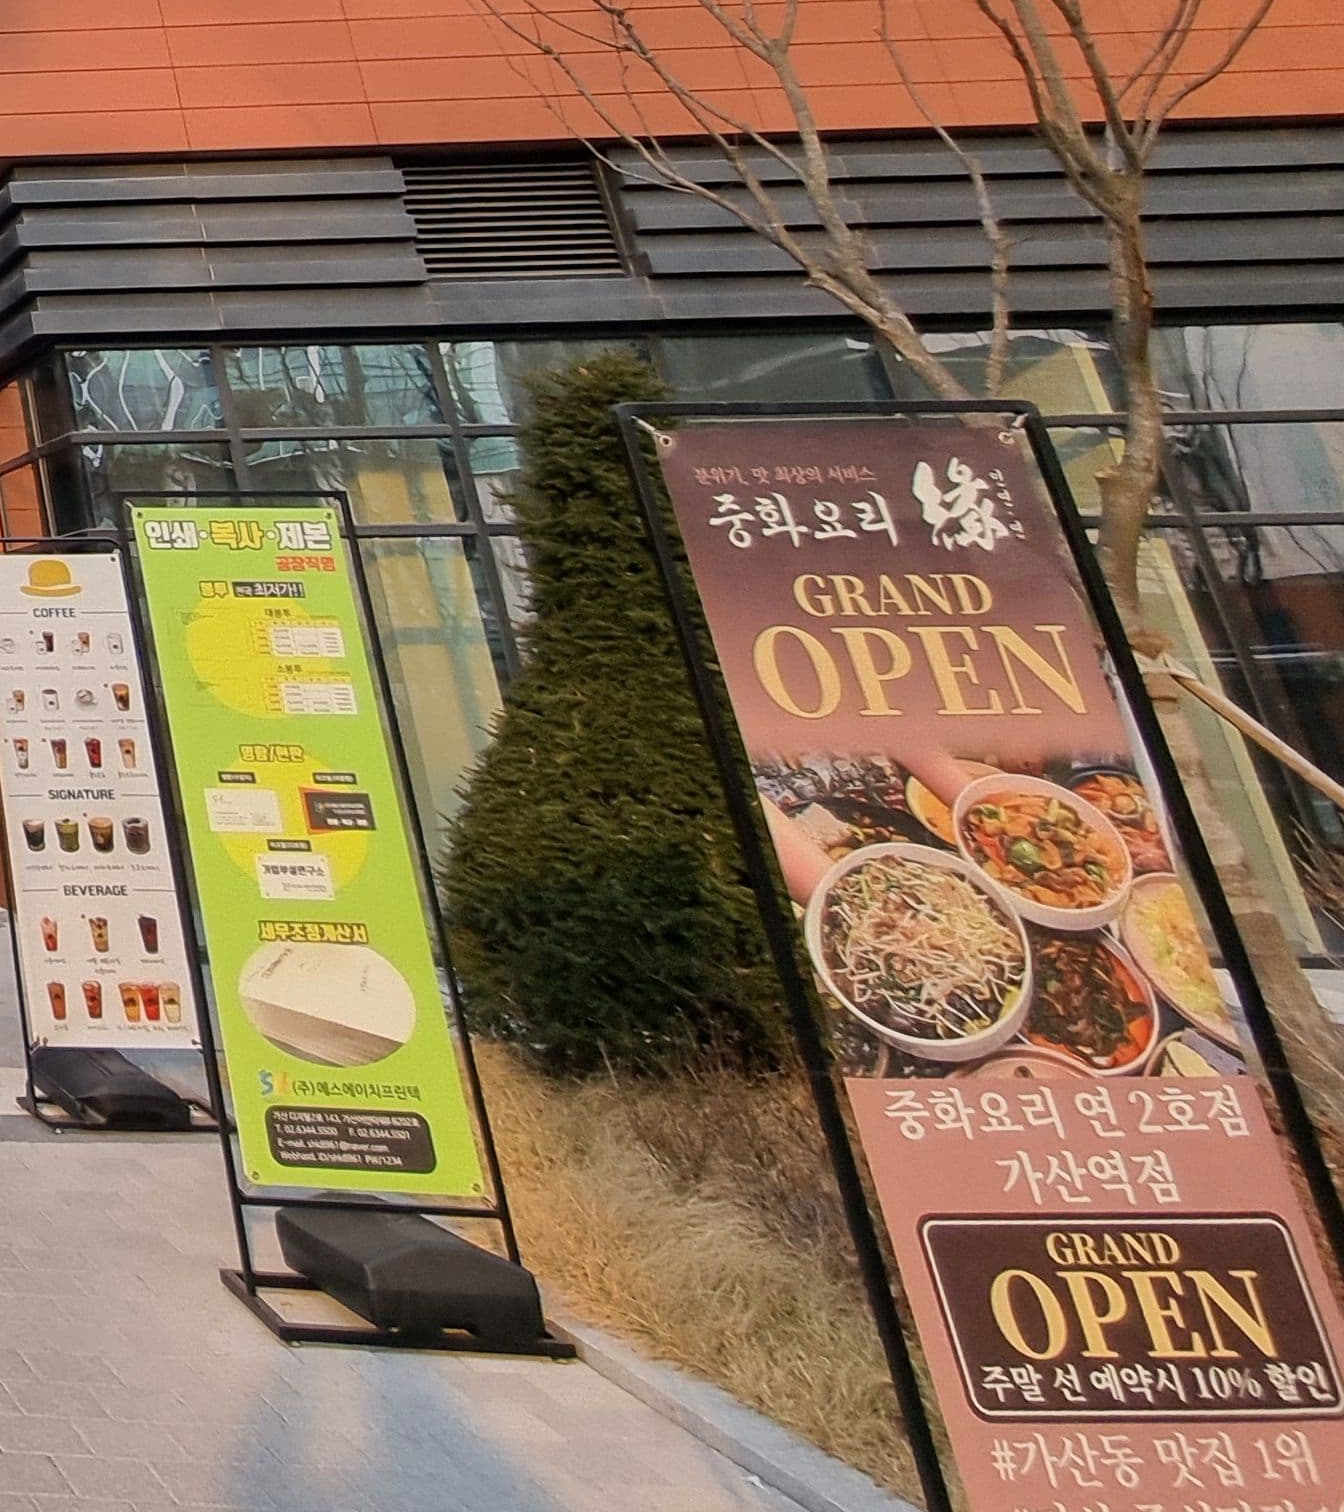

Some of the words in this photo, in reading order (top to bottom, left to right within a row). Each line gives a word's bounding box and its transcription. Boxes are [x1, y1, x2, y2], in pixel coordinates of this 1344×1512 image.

[709, 491, 899, 549] 중화요리
[32, 607, 76, 619] COFFEE
[793, 573, 994, 617] GRAND
[752, 624, 1089, 719] OPEN
[48, 789, 116, 800] SIGNATURE
[63, 885, 128, 896] BEVERAGE
[884, 1087, 1065, 1141] 중화요리
[1075, 1086, 1126, 1138] 연
[1128, 1084, 1251, 1138] 2호점
[996, 1150, 1182, 1205] 가산역점
[1046, 1232, 1180, 1265] GRAND
[990, 1269, 1279, 1360] OPEN
[980, 1364, 1042, 1402] 주말
[1053, 1364, 1089, 1402] 선
[1091, 1364, 1188, 1404] 예약시
[1191, 1365, 1262, 1400] 10%
[1266, 1363, 1334, 1404] 할인
[991, 1432, 1145, 1489] #가산동
[1153, 1431, 1245, 1488] 맛집
[1254, 1430, 1321, 1486] 1위
